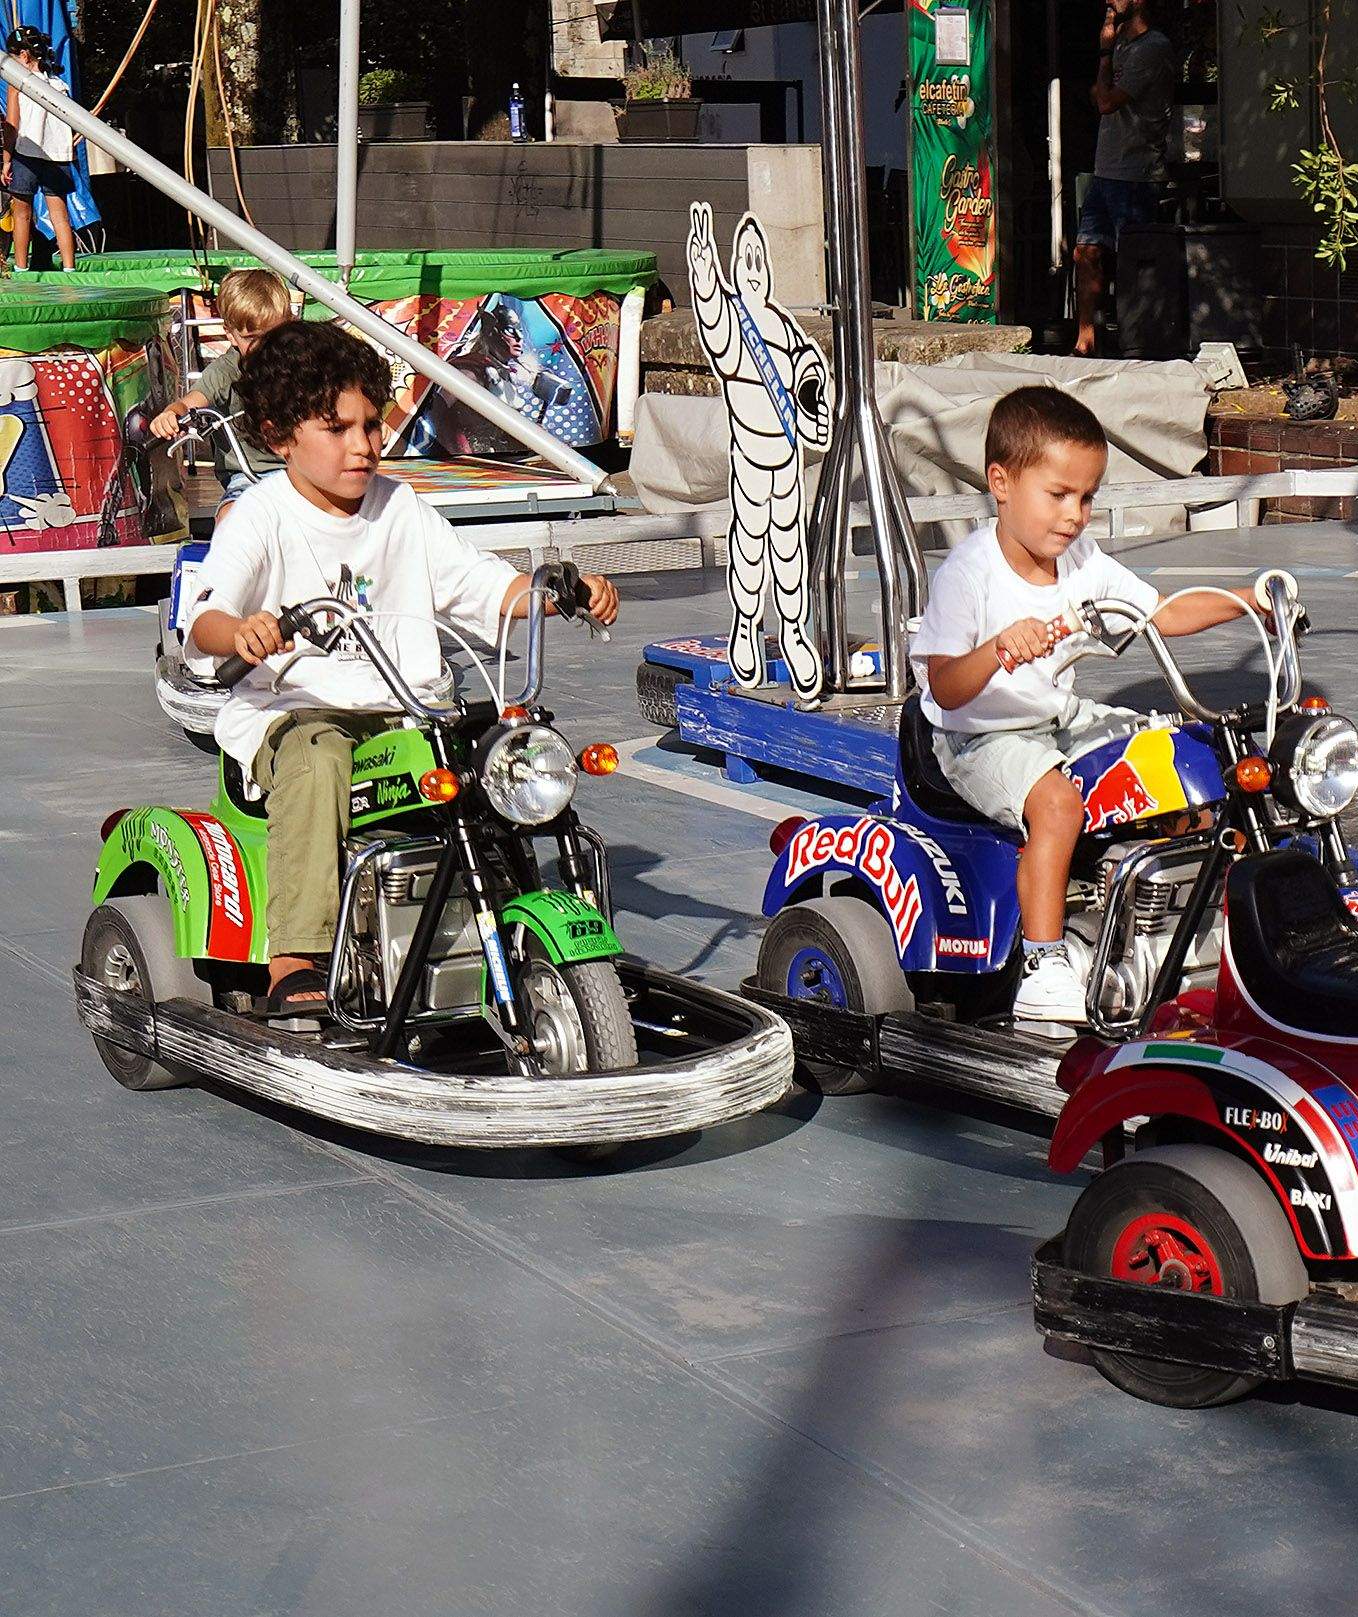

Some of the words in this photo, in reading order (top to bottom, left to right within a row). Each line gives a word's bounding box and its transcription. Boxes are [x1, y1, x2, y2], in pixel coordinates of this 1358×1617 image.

[941, 154, 980, 199] Gastro
[944, 188, 992, 233] Garden
[733, 297, 797, 440] MICHELIN
[353, 745, 397, 775] awasaki
[377, 777, 412, 808] Ninja
[785, 816, 874, 888] Red
[859, 824, 923, 960] Bull
[939, 938, 988, 955] MOTUL
[1262, 1142, 1320, 1169] Unibat
